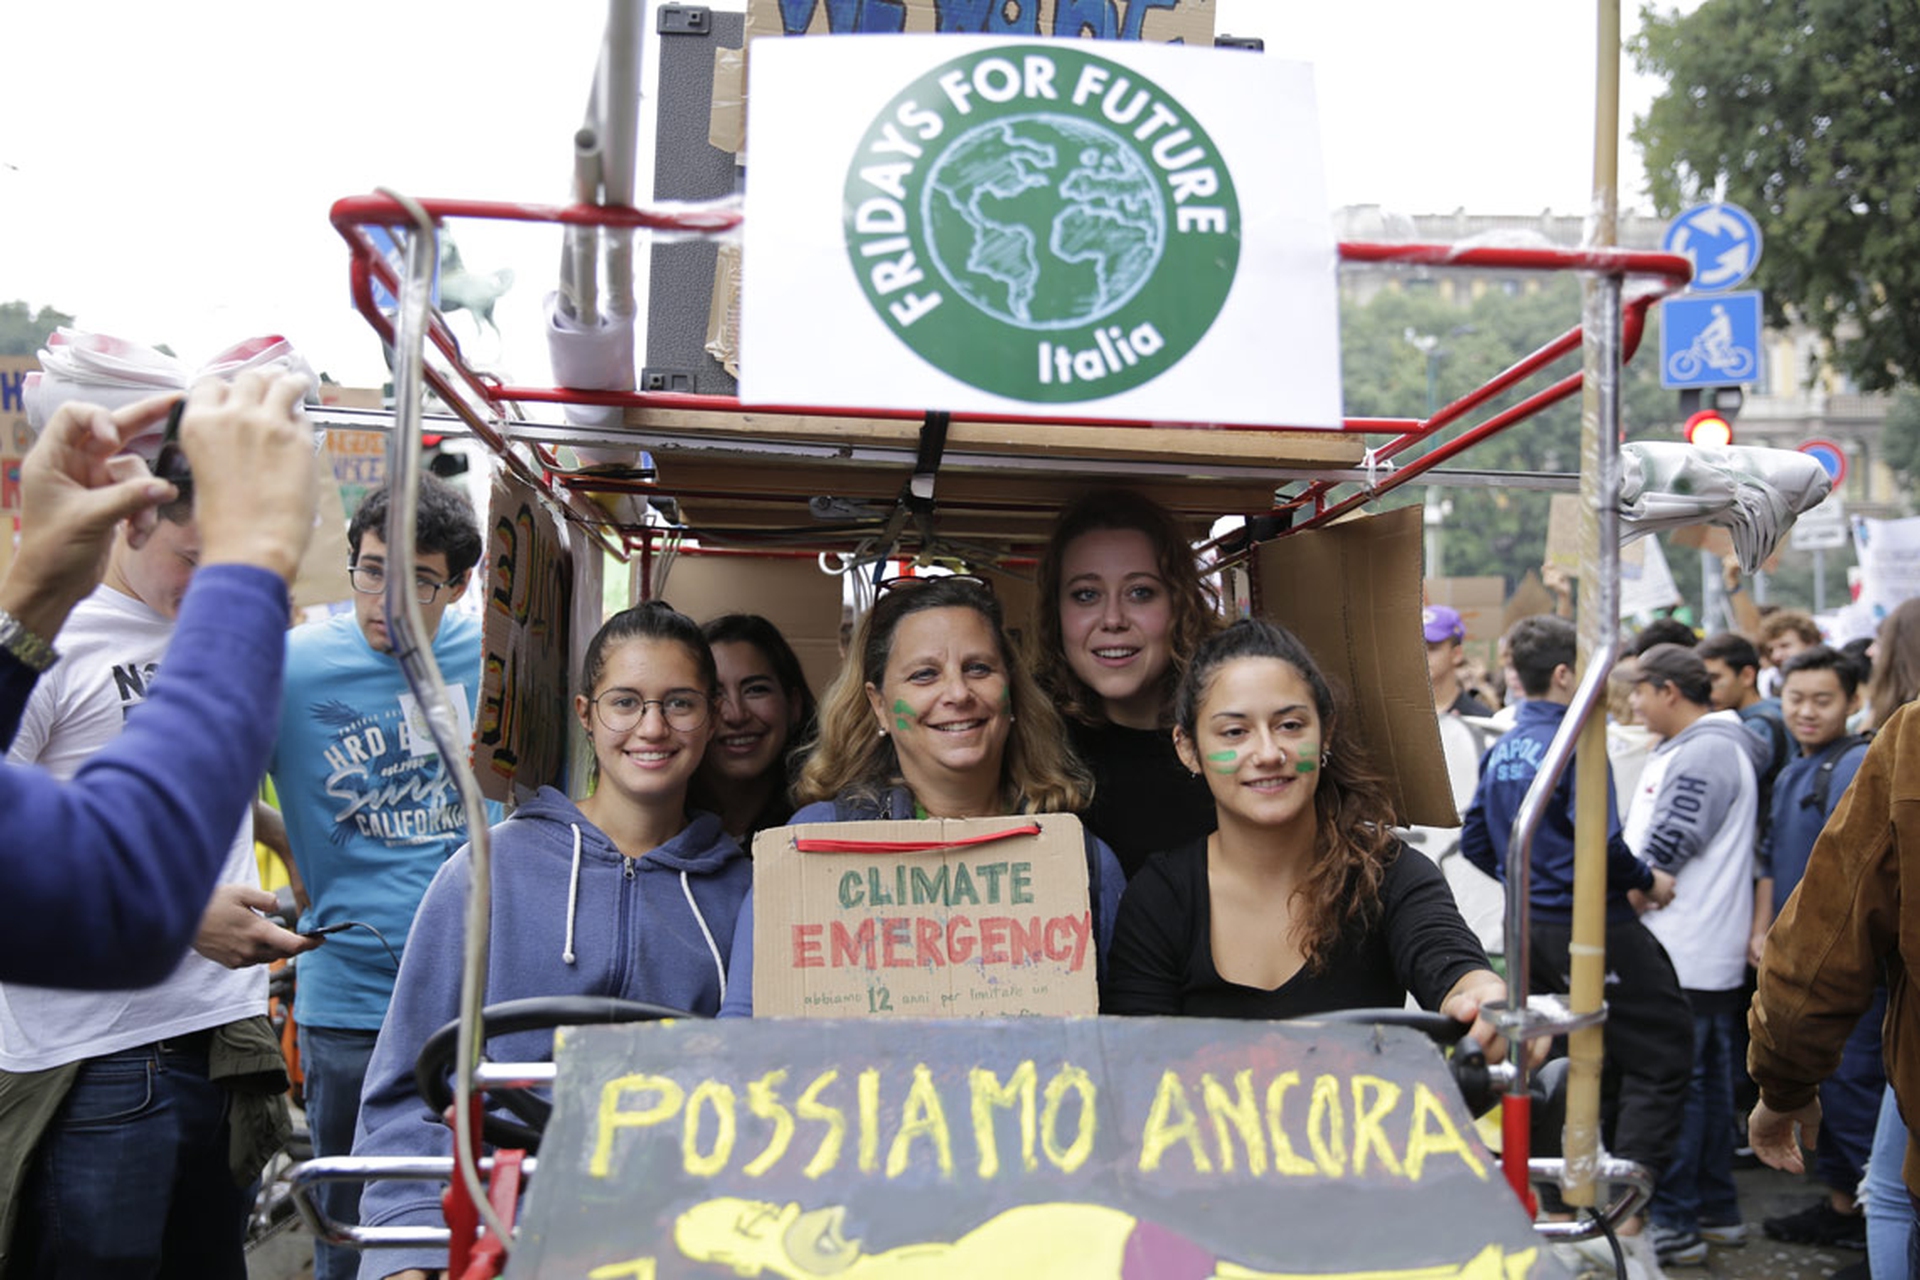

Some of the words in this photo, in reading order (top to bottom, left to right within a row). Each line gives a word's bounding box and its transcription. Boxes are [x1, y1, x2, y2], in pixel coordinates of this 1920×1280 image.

[855, 100, 944, 327] FRIDAYS
[938, 54, 1058, 115] FOR
[1071, 63, 1227, 234] FUTURE
[1038, 321, 1164, 384] Italia
[323, 726, 387, 772] HRD
[355, 802, 466, 839] CALIFORNIA
[838, 861, 1035, 909] CLIMATE
[791, 910, 1093, 973] EMERGENCY
[866, 986, 895, 1014] 12
[901, 993, 931, 1005] anni
[940, 991, 961, 1008] per
[1032, 985, 1050, 996] un
[588, 1058, 1097, 1180] POSSIAMO
[1138, 1068, 1490, 1182] ANCORA
